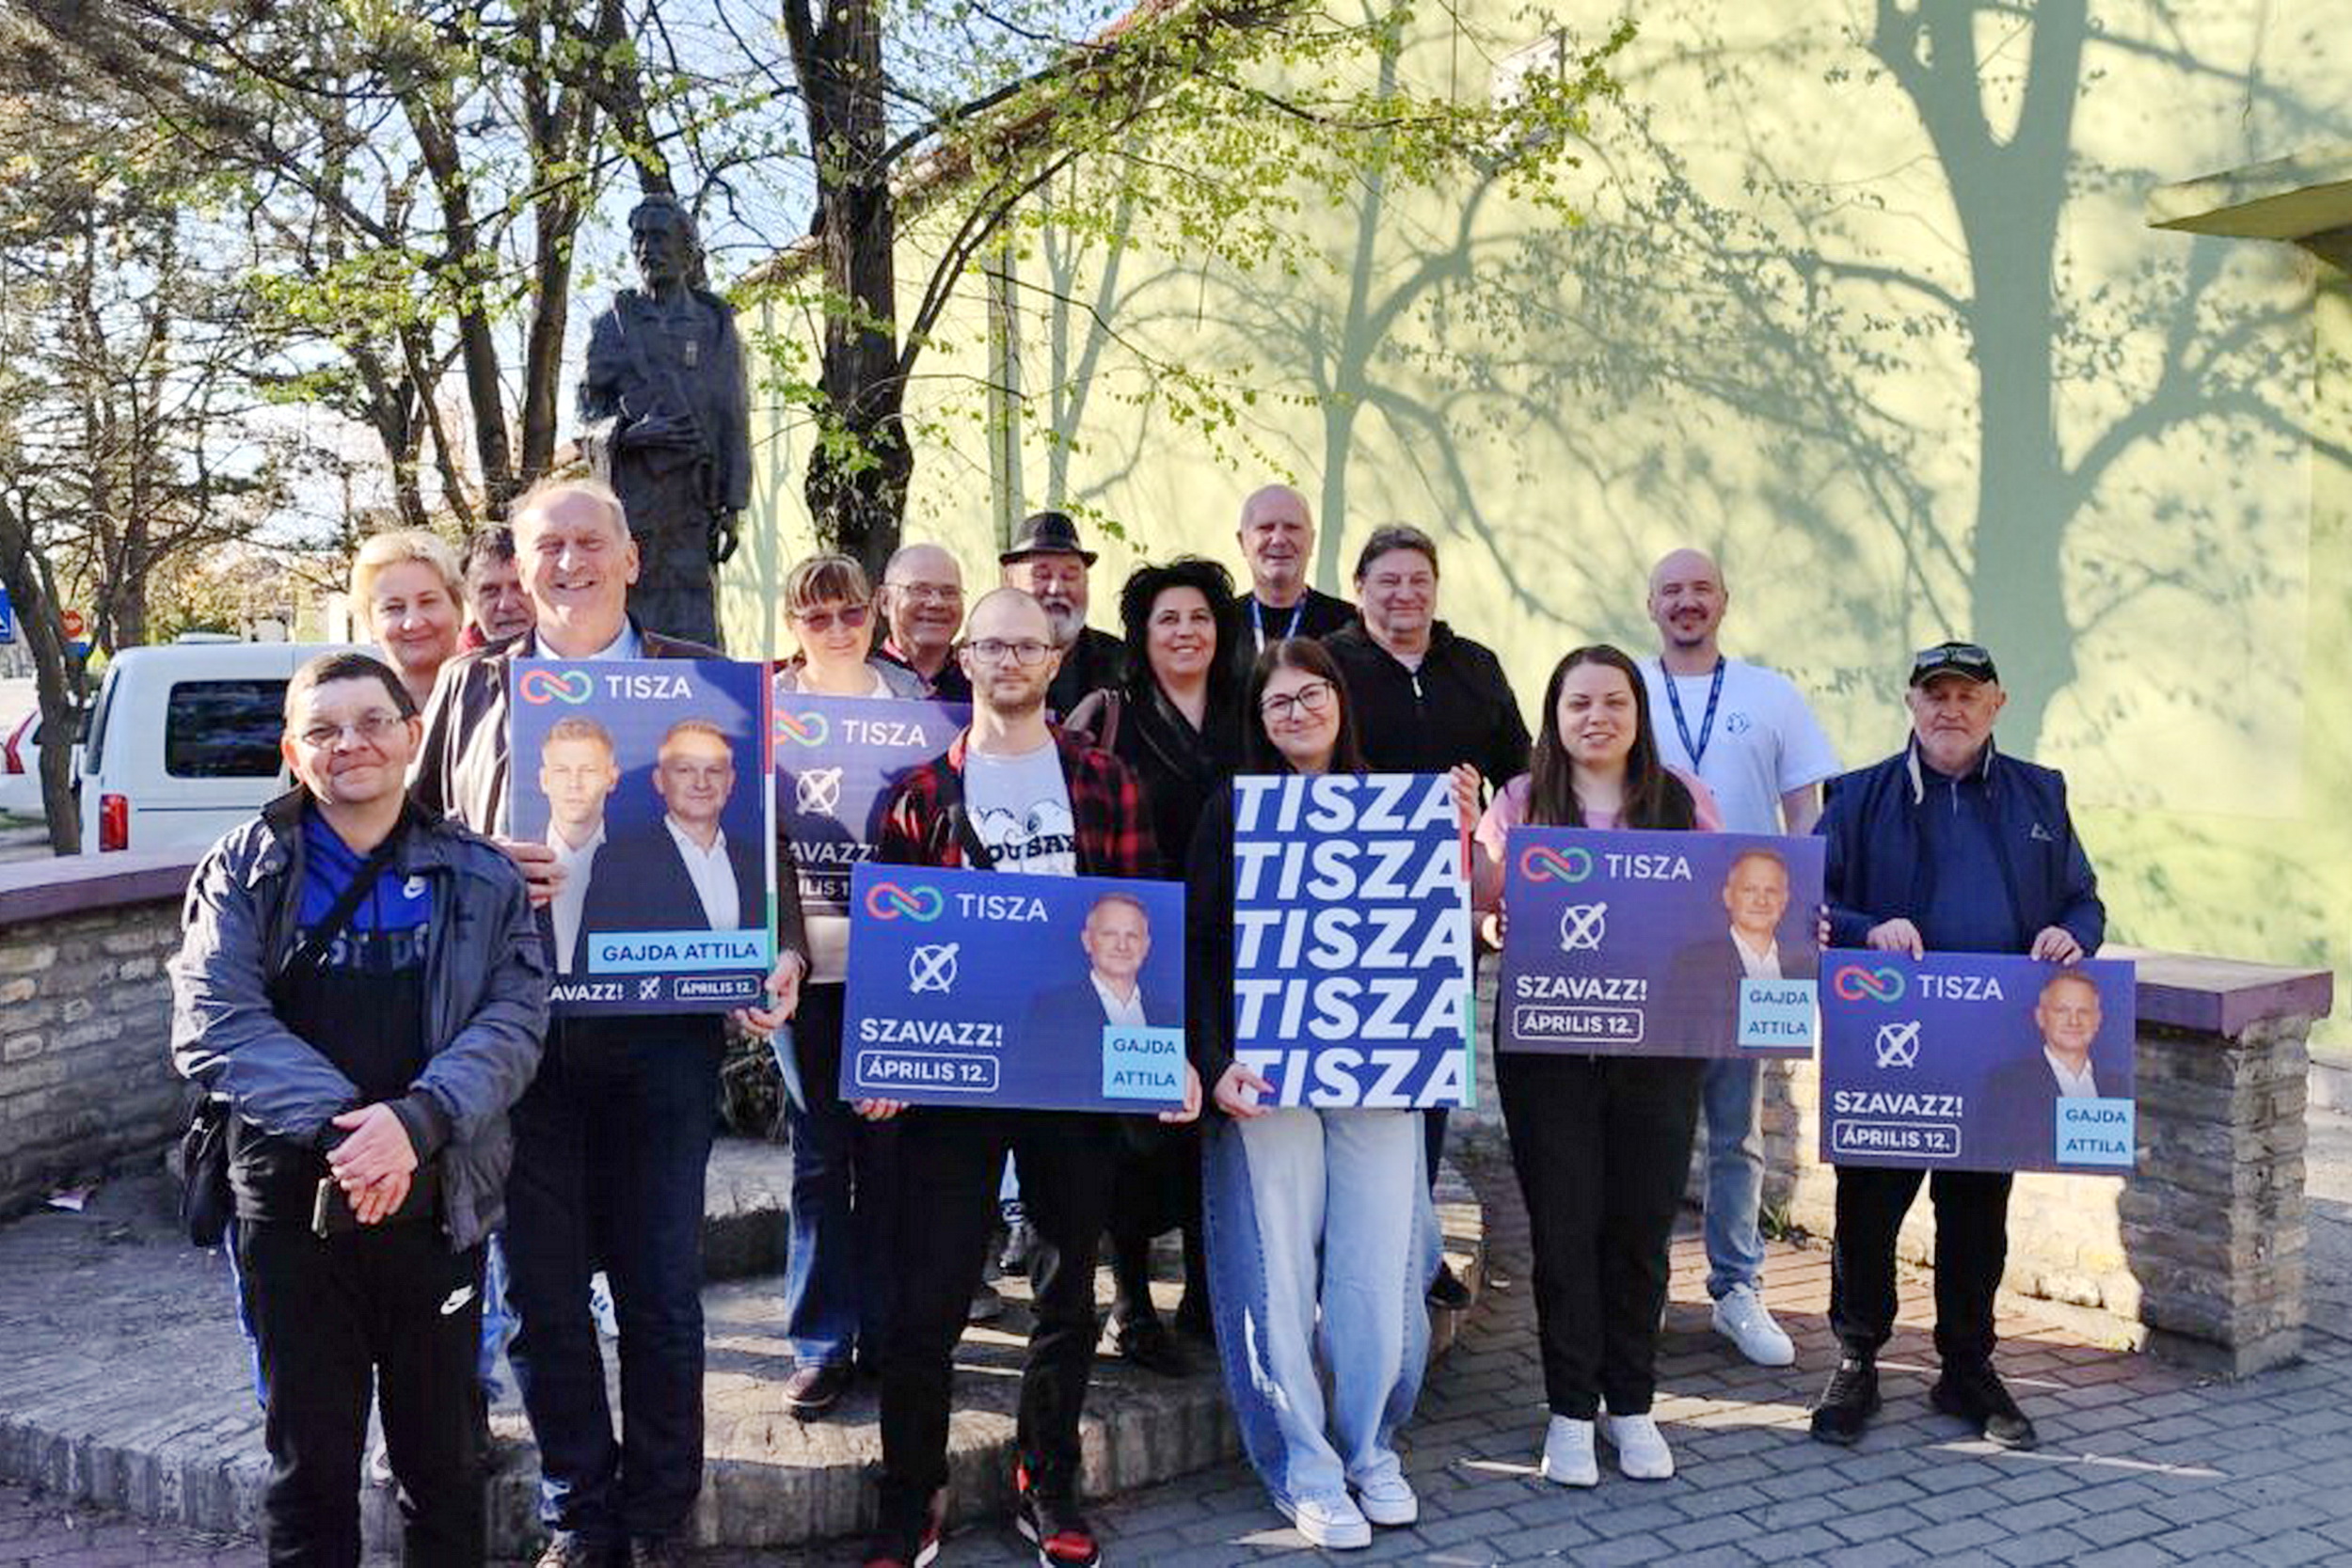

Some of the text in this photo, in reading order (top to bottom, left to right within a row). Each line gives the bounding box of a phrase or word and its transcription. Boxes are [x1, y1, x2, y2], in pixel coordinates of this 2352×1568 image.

[605, 675, 692, 699] TISZA
[842, 720, 927, 747] TISZA
[1234, 774, 1460, 834] TISZA
[788, 841, 880, 863] AVAZZ
[1234, 839, 1461, 901] TISZA
[1605, 853, 1692, 880] TISZA
[956, 893, 1048, 922] TISZA
[602, 942, 758, 961] GAJDA ATTILA
[1234, 908, 1464, 970] TISZA
[549, 983, 624, 1002] AVAZZ!
[1516, 975, 1647, 1002] SZAVAZZ!
[1749, 989, 1810, 1006] GAJDA
[1917, 974, 2004, 1001] TISZA
[1234, 978, 1467, 1039] TISZA
[1523, 1010, 1633, 1034] ÁPRILIS 12.
[860, 1018, 1003, 1048] SZAVAZZ!
[1748, 1020, 1807, 1035] ATTILA
[1113, 1038, 1177, 1055] GAJDA
[866, 1055, 989, 1084] ÁPRILIS 12.
[1113, 1070, 1177, 1087] ATTILA
[1236, 1048, 1468, 1108] TISZA
[1834, 1090, 1963, 1117] SZAVAZZ!
[2065, 1108, 2126, 1124] GAJDA
[1841, 1124, 1951, 1150] ÁPRILIS 12.
[2065, 1138, 2126, 1154] ATTILA
